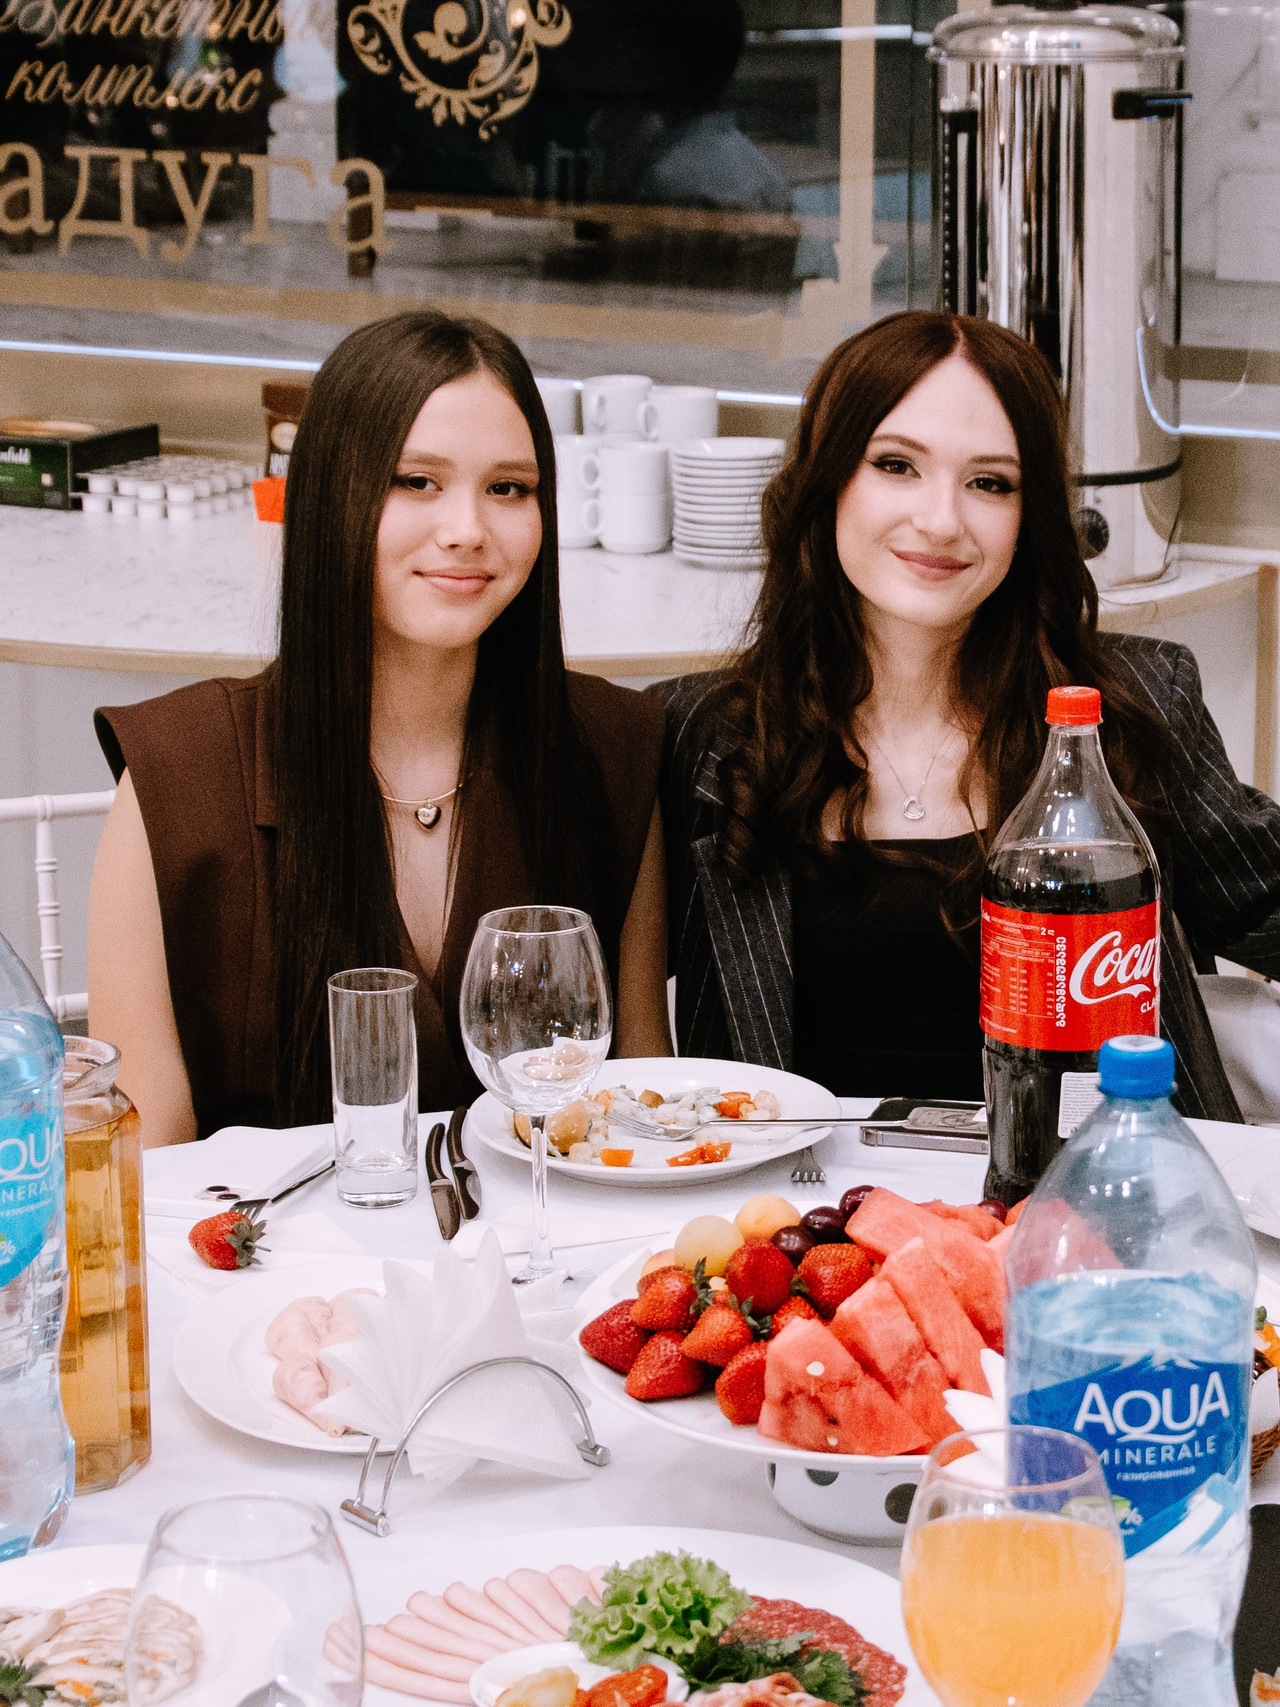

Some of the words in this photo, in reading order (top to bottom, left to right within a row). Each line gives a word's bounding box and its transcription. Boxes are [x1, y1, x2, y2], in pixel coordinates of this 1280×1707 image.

[4, 59, 264, 113] комплекс
[0, 141, 396, 263] адуга
[0, 1116, 62, 1182] QUA
[1073, 1371, 1231, 1444] AQUA
